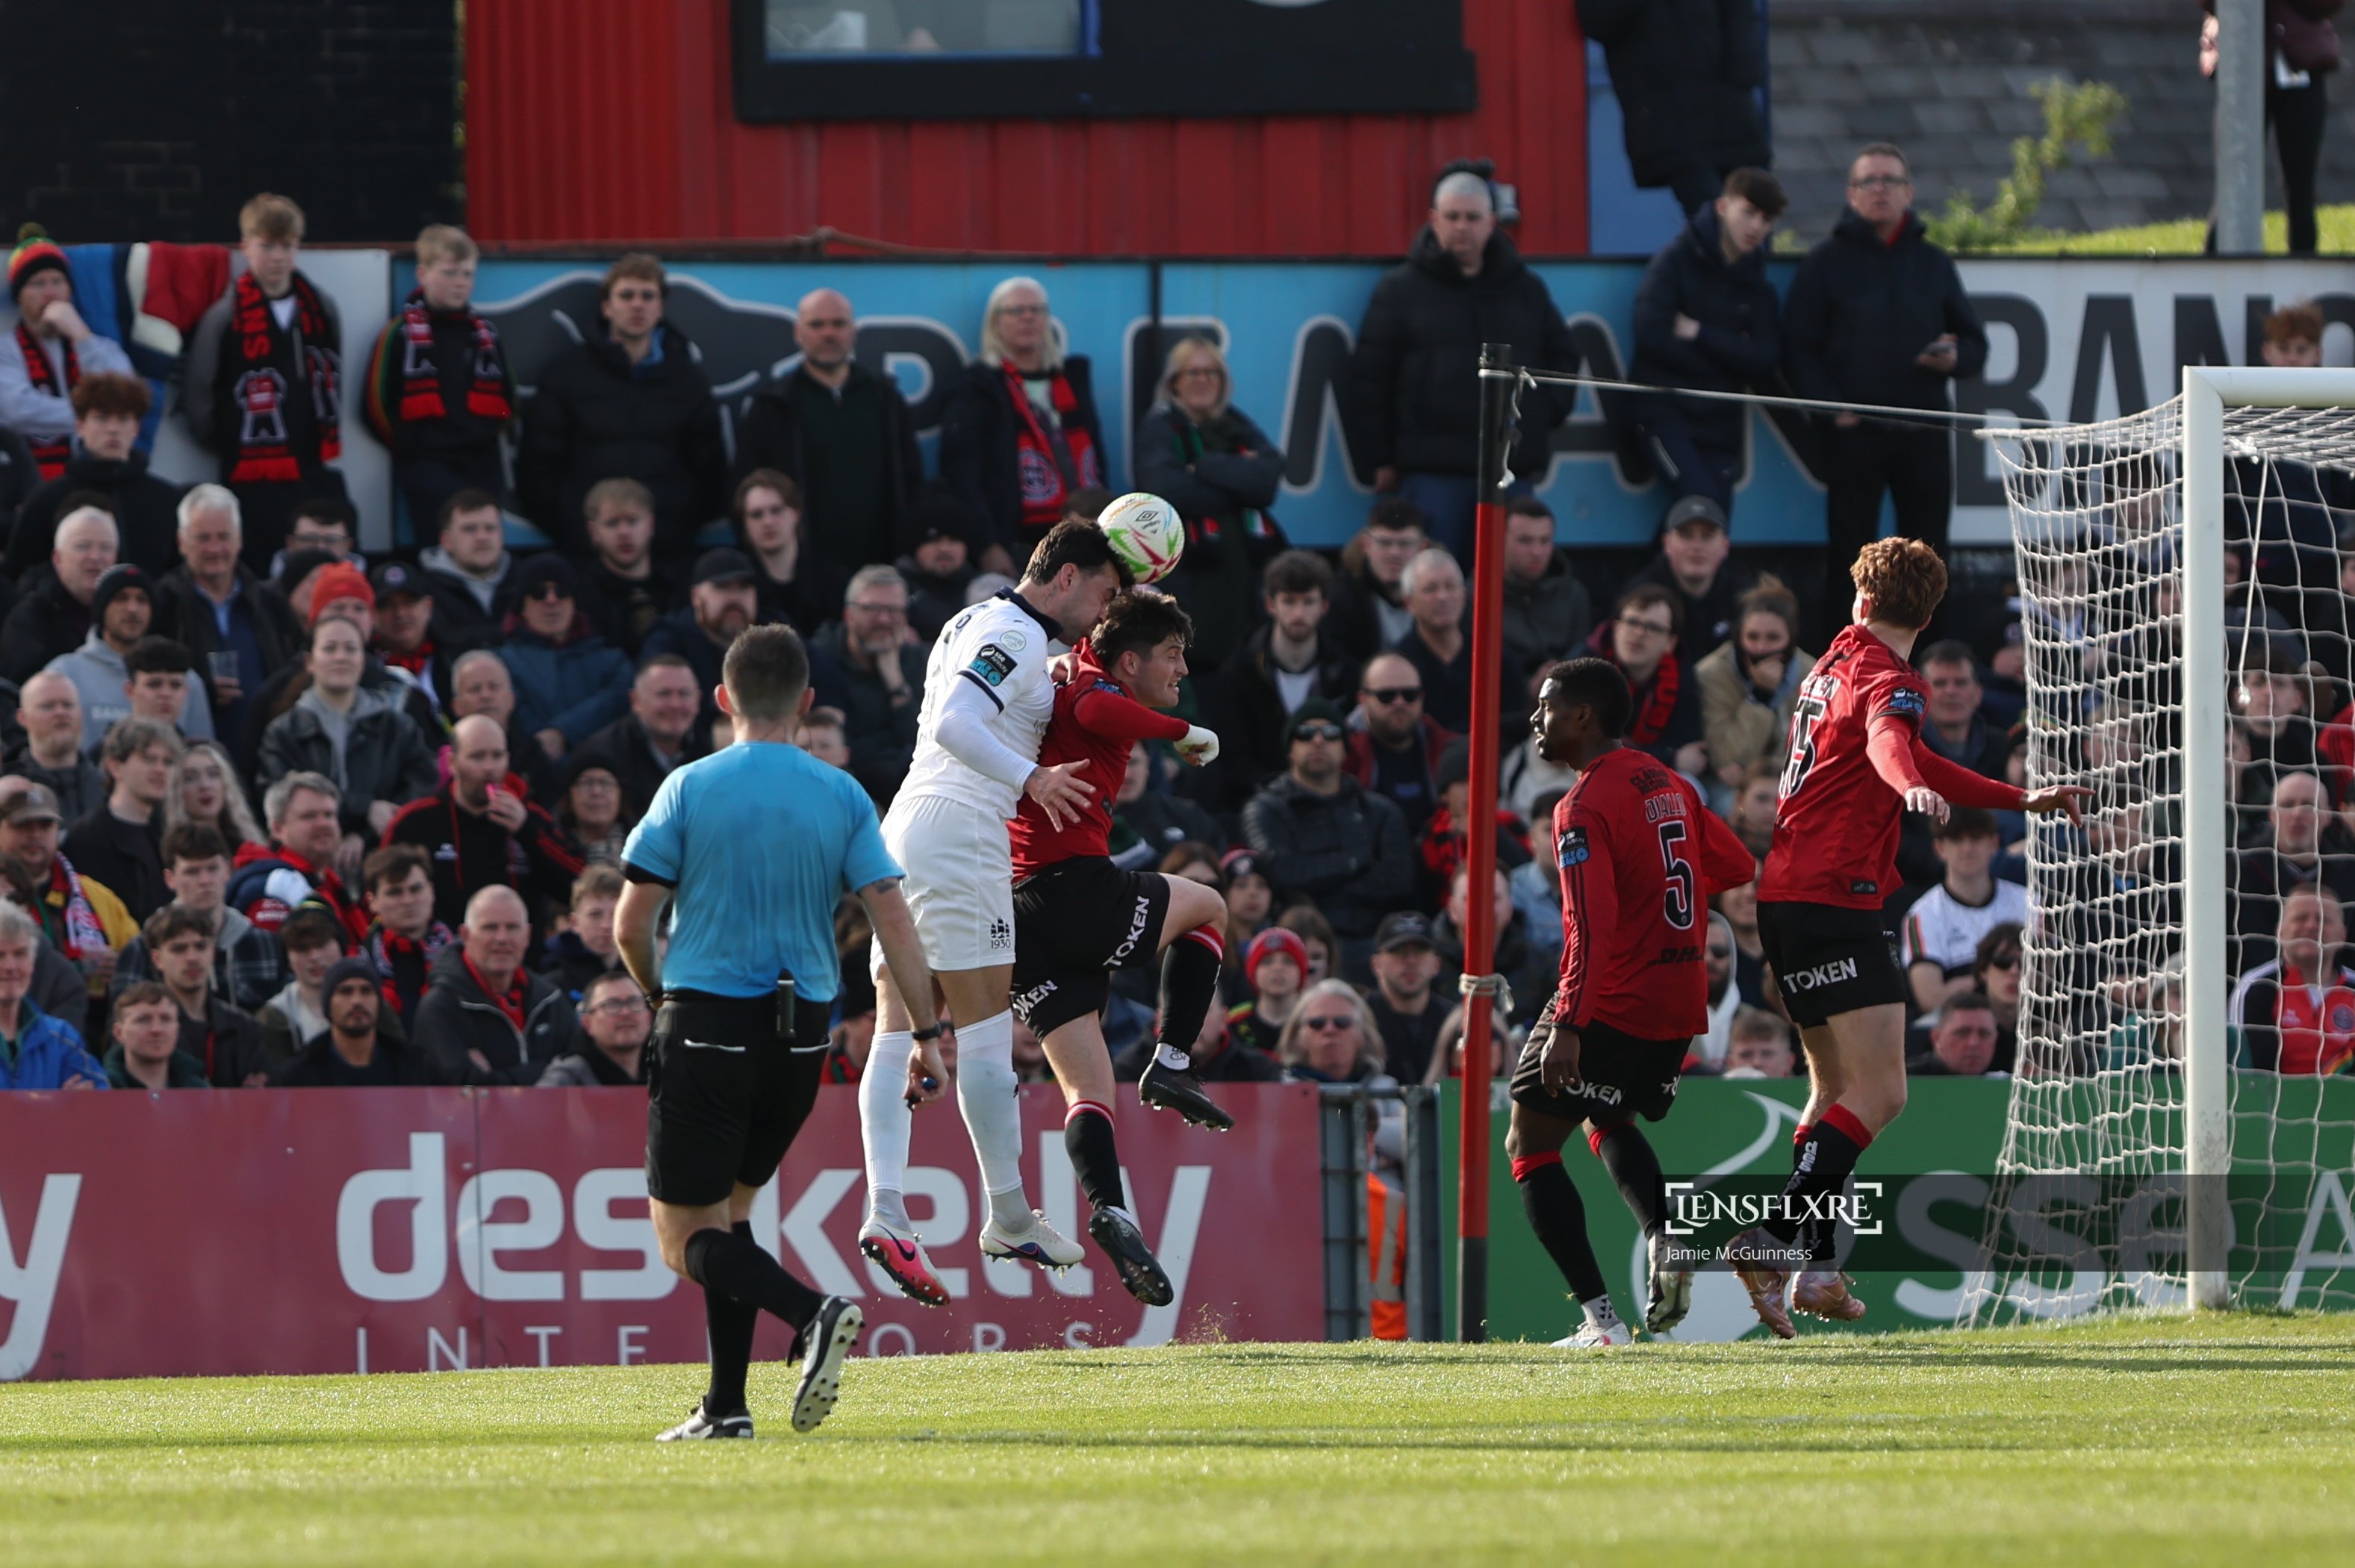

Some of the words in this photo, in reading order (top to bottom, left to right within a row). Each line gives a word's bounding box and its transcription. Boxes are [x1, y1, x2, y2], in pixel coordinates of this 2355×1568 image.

[1645, 792, 1687, 824] DIALLO
[1658, 820, 1693, 931] 5
[990, 939, 1011, 949] 1930
[1103, 896, 1150, 967] TOKEN
[1784, 957, 1858, 994] TOKEN
[1012, 980, 1058, 1022] OKEN
[1565, 1080, 1626, 1105] OKEN
